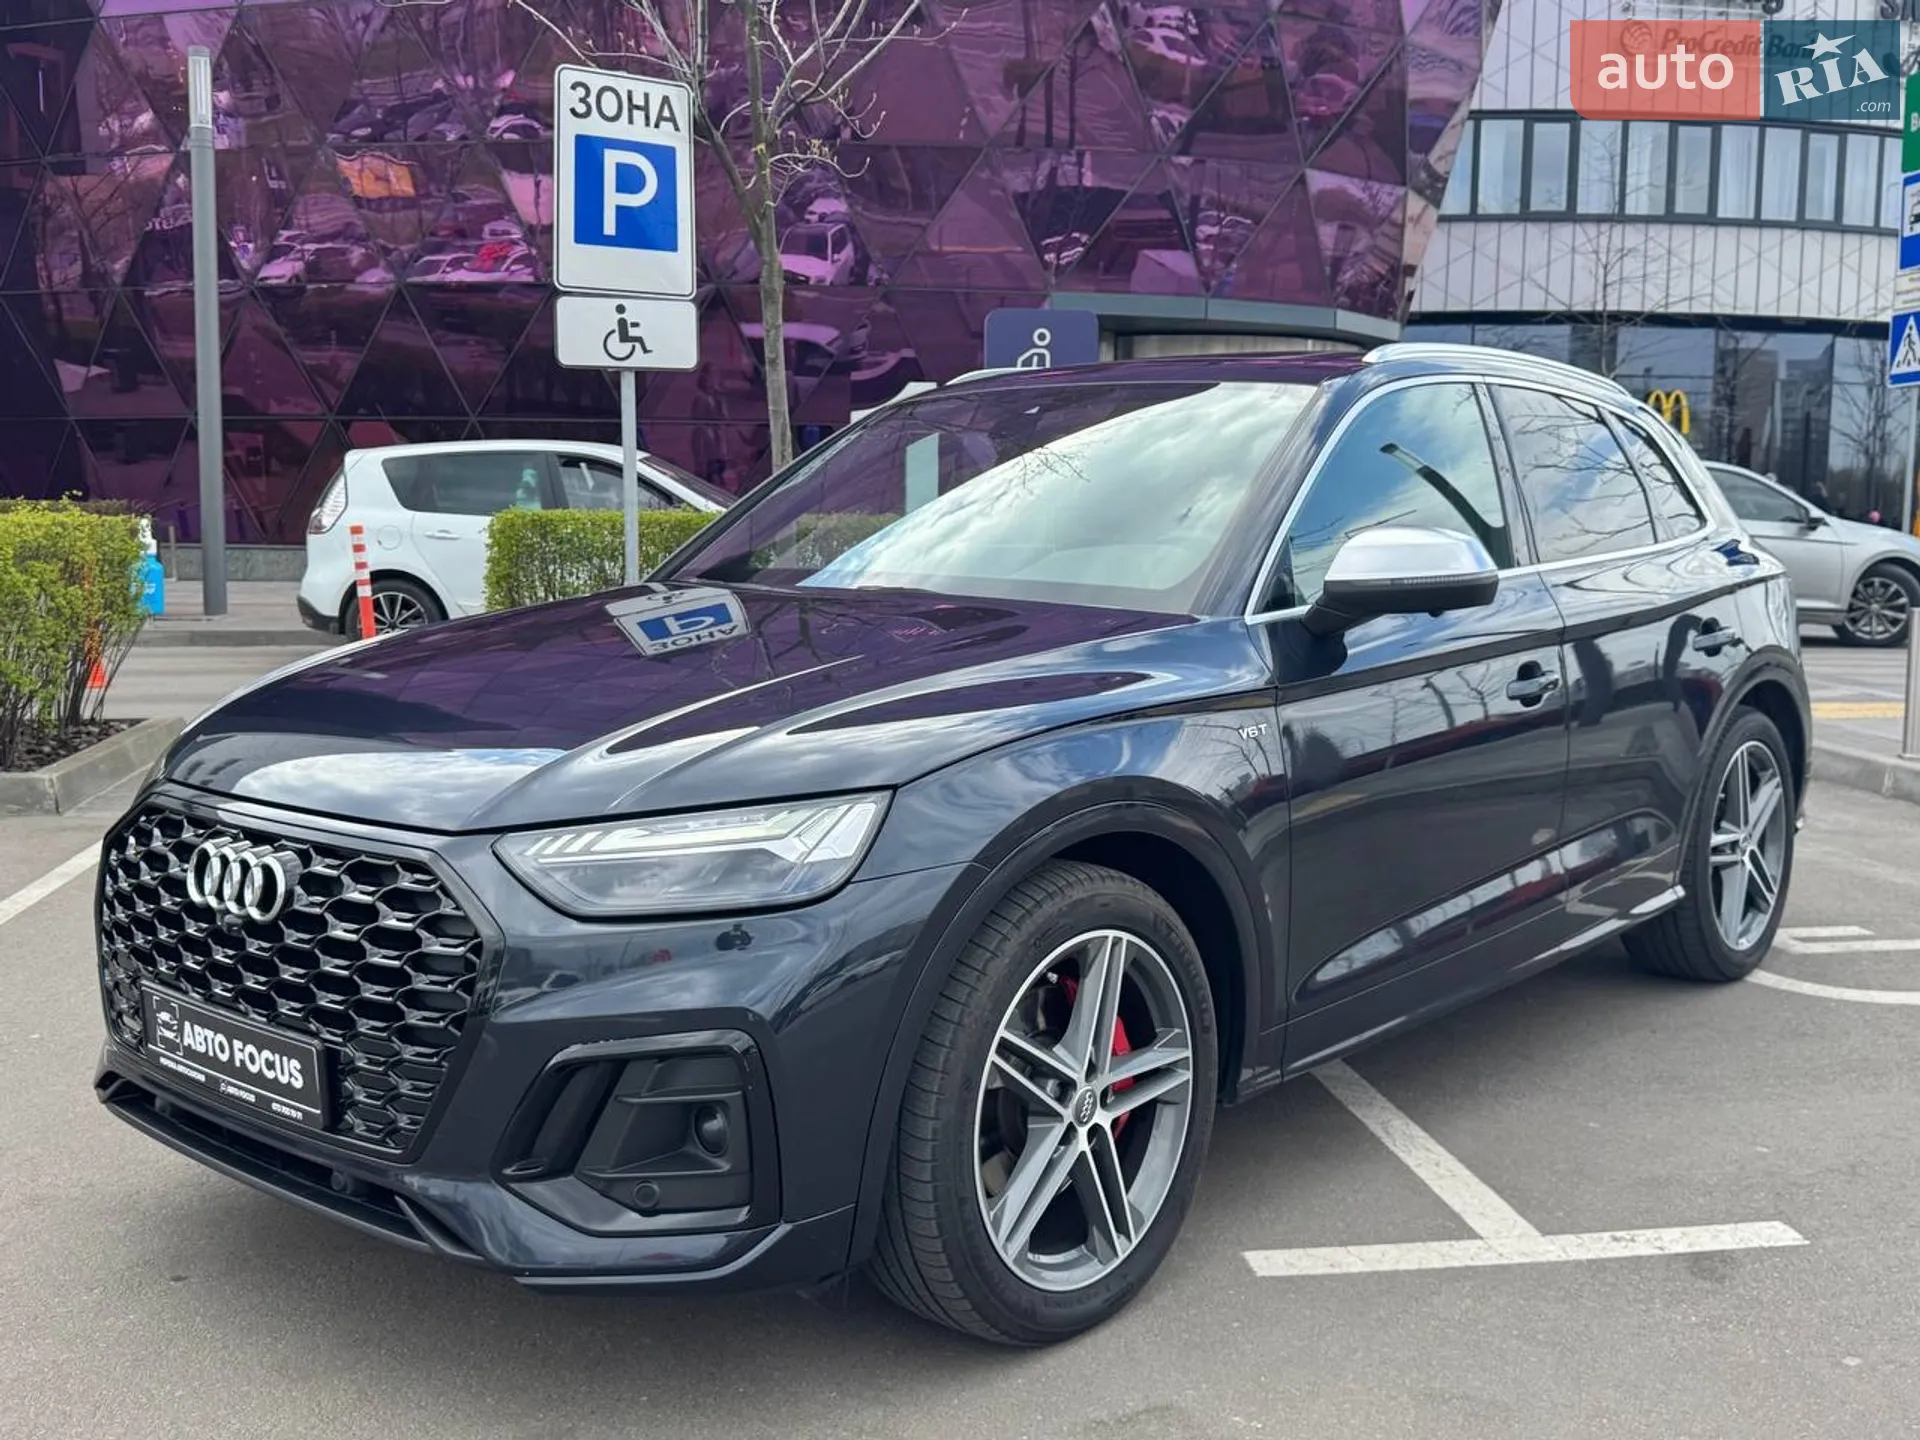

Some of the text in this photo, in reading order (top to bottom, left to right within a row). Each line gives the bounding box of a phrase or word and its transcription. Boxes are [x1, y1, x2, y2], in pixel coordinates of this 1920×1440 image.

[569, 81, 681, 132] ЗОНА
[603, 149, 658, 236] P
[232, 1038, 304, 1089] FOCUS
